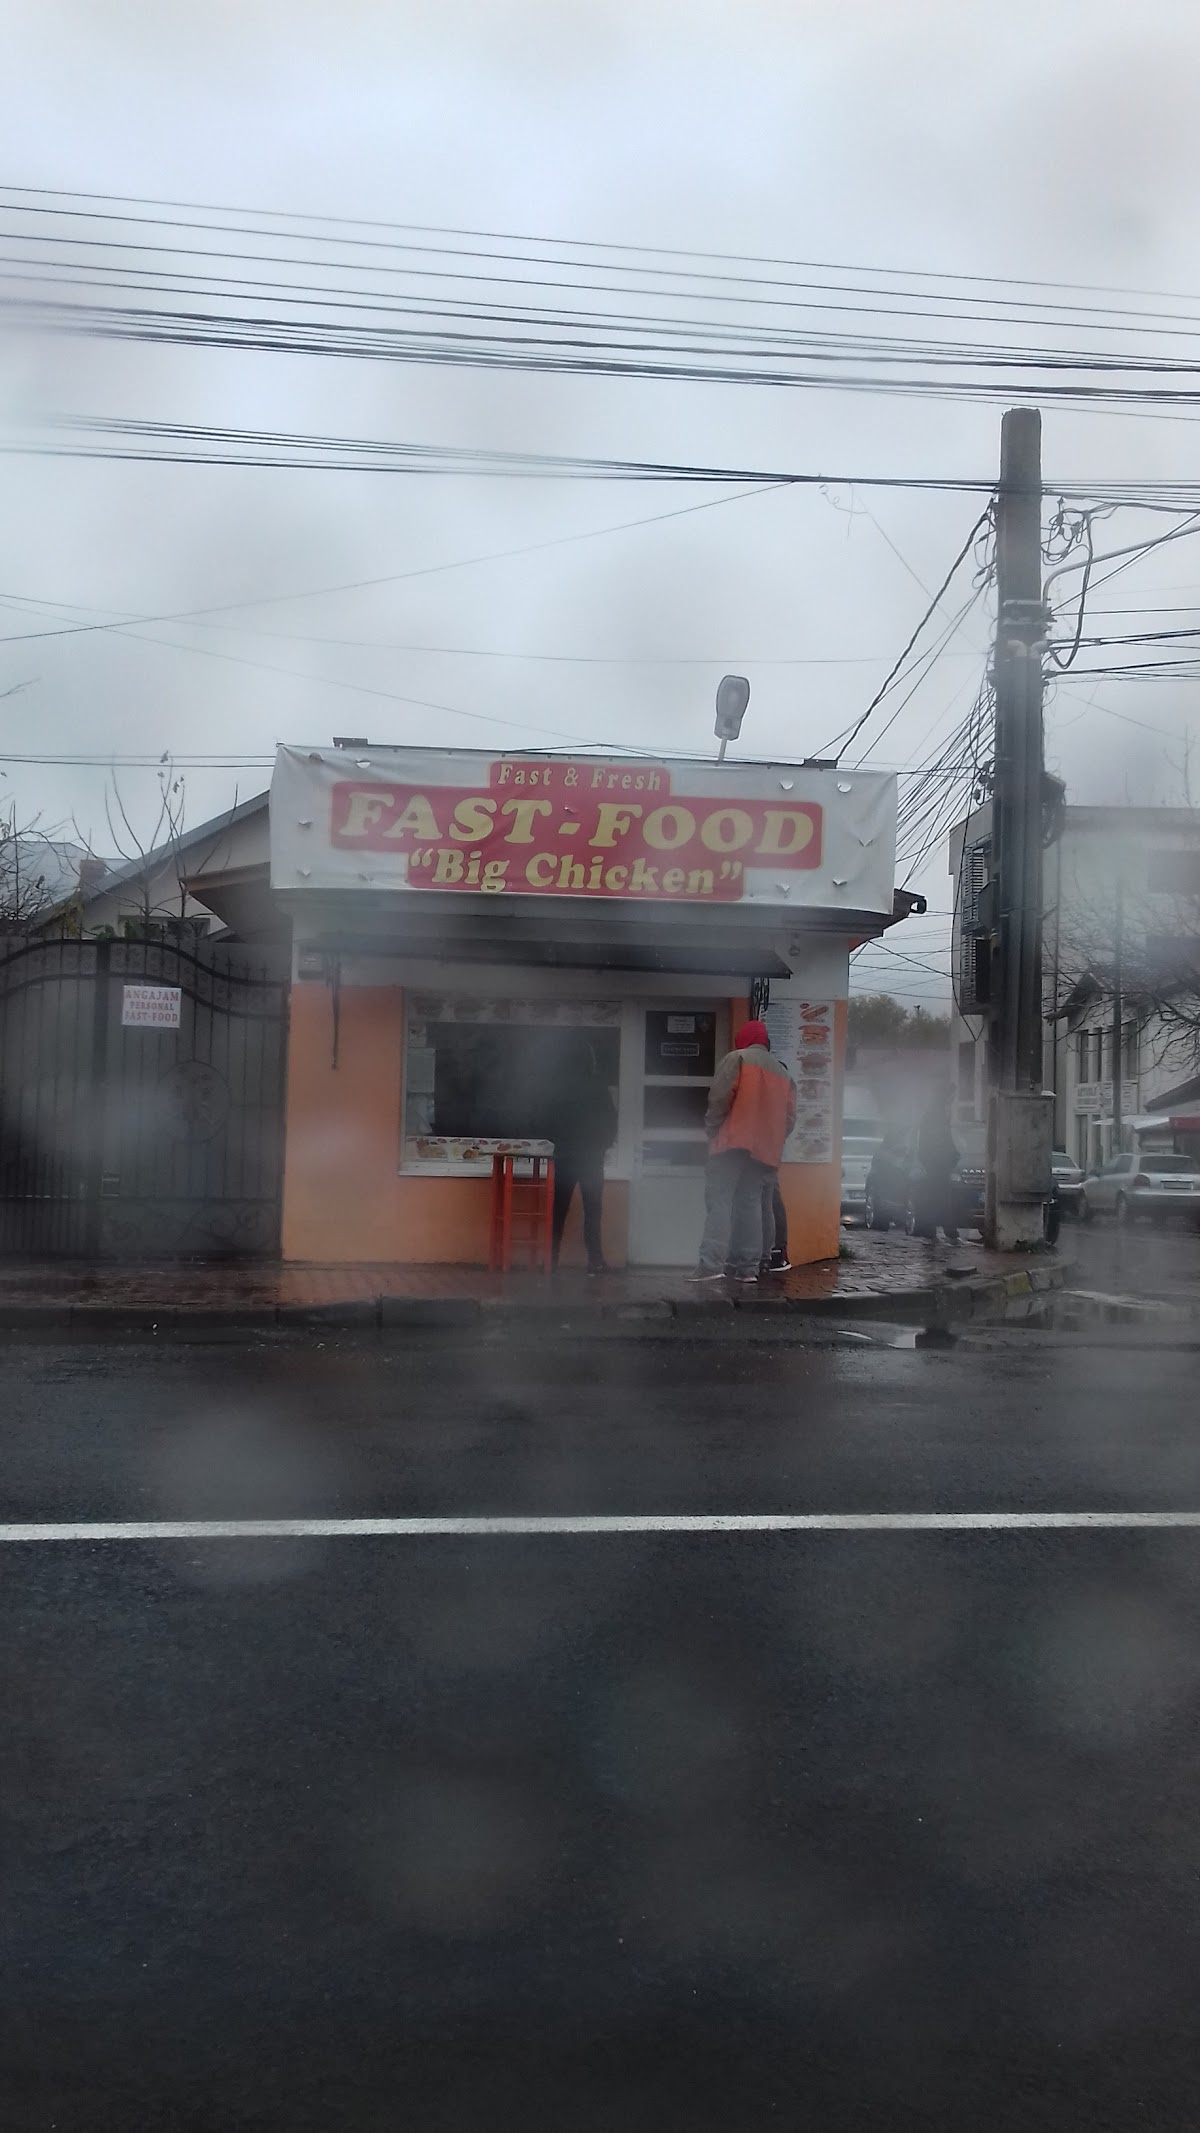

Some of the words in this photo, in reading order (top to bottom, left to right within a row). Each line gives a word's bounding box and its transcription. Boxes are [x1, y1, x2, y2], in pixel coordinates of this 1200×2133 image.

[498, 763, 552, 785] Fast
[564, 767, 579, 787] &
[591, 767, 661, 791] Fresh
[126, 990, 179, 1001] ANGAJAM
[130, 1001, 174, 1011] PERSONAL
[124, 1011, 178, 1022] FAST-FOOD
